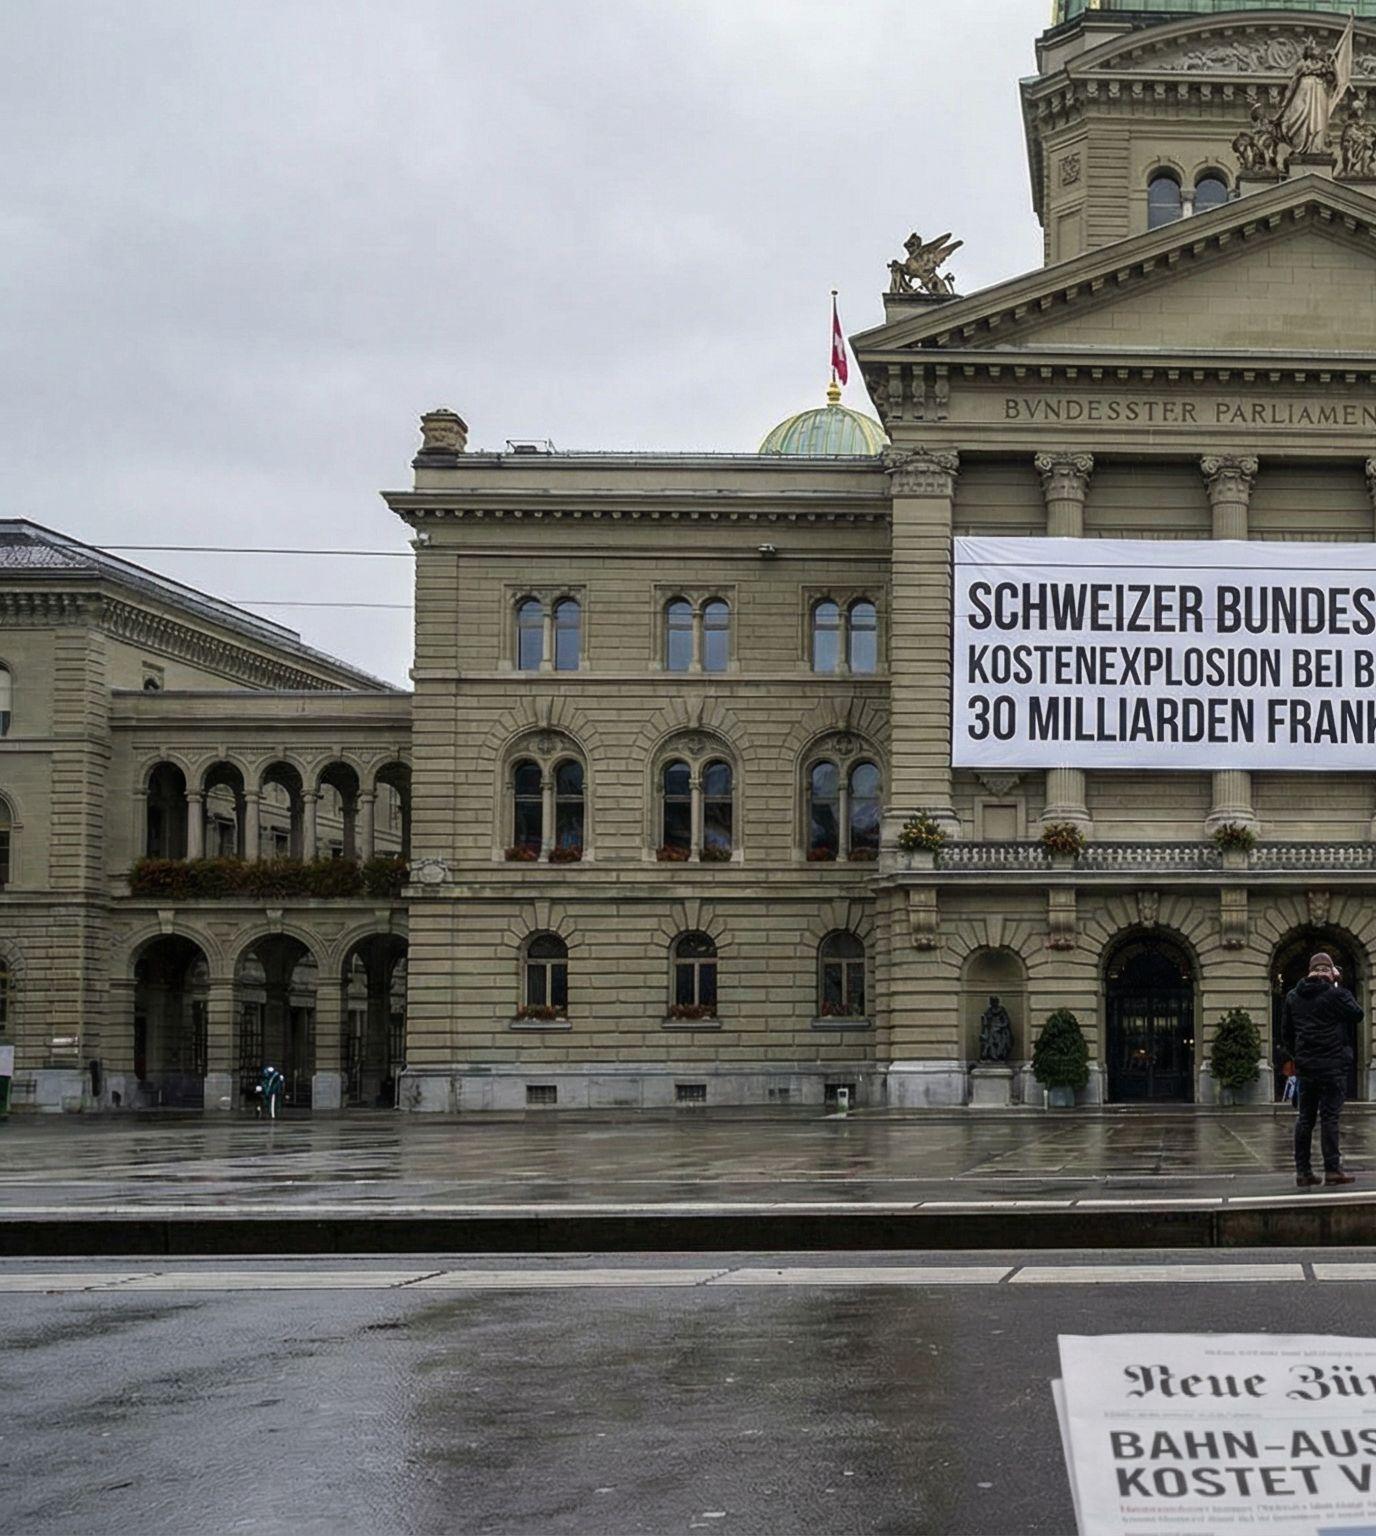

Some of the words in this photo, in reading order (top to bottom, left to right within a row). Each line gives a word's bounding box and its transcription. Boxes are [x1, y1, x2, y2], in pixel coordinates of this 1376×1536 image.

[968, 581, 1203, 633] SCHWEIZER
[968, 644, 1281, 688] KOSTENEXPLOSION
[1292, 648, 1343, 688] BEI
[968, 695, 1016, 741] 30
[1028, 696, 1254, 744] MILLIARDEN
[1123, 1364, 1269, 1399] Neue
[1115, 1465, 1321, 1498] KOSTET
